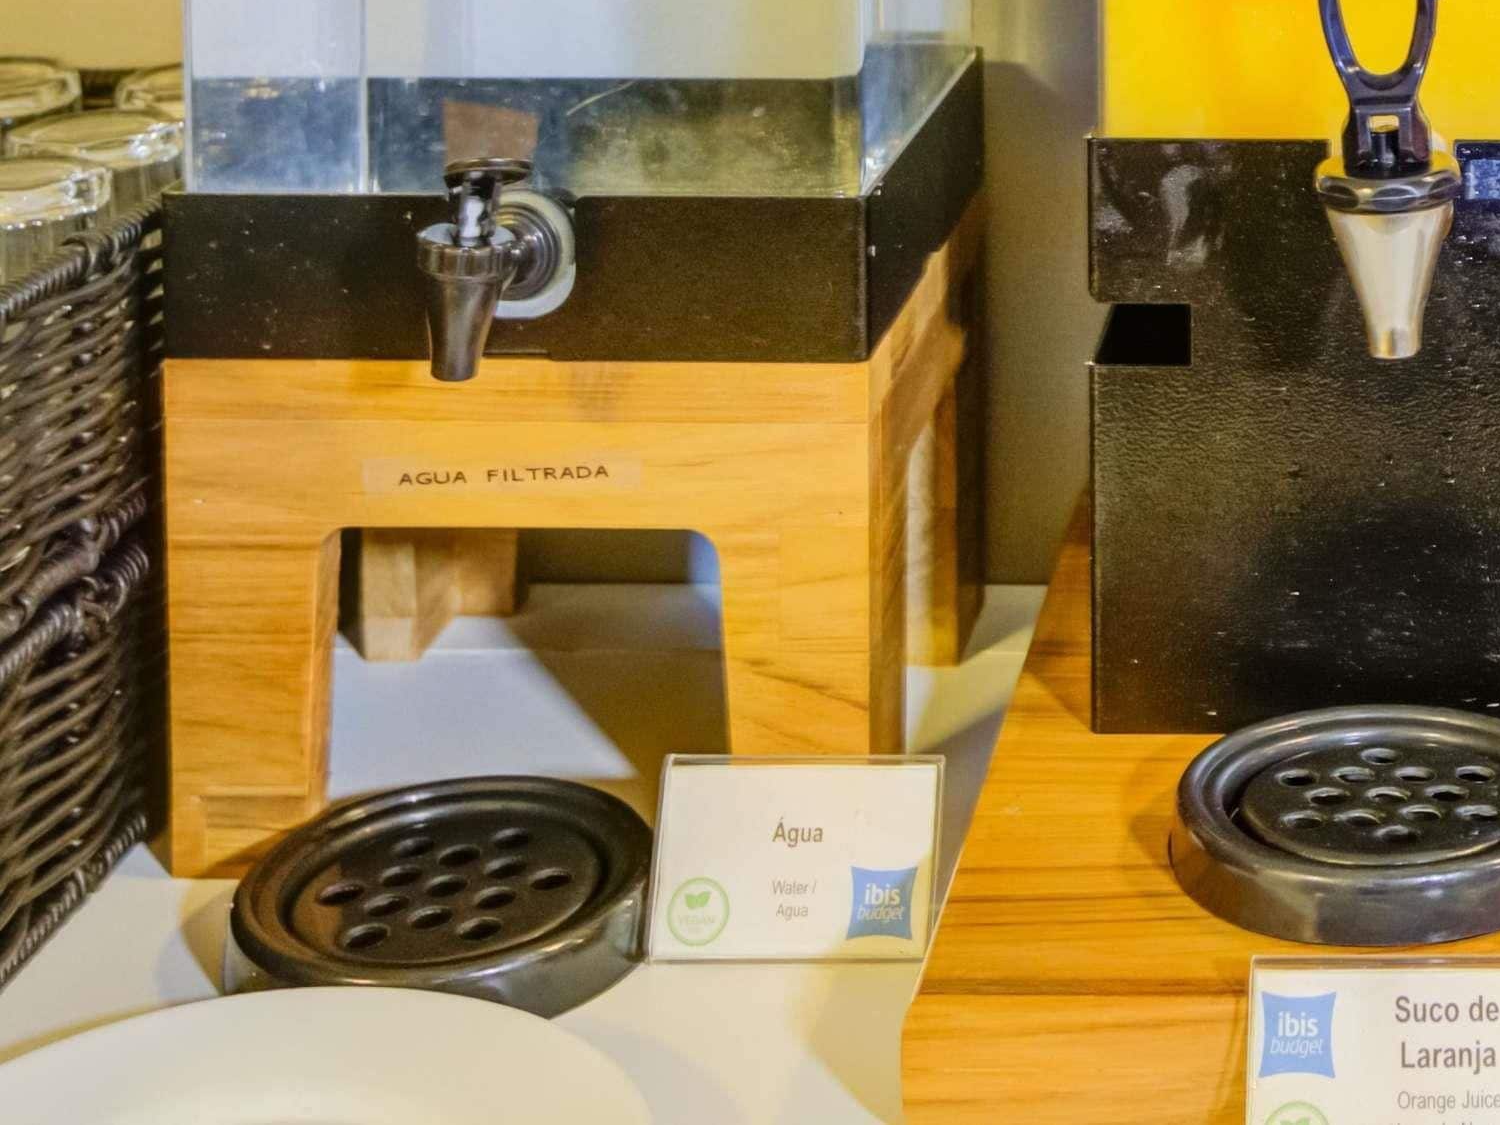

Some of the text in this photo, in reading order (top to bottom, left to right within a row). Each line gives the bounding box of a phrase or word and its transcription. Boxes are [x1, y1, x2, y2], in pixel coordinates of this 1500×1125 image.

[398, 465, 610, 486] AGUA FILTRADA
[771, 816, 825, 848] Água
[771, 879, 808, 896] Water
[864, 882, 901, 906] ibis
[775, 903, 809, 921] Agua
[856, 904, 905, 924] budget
[1394, 994, 1500, 1023] Suco de
[1276, 1010, 1319, 1038] ibis
[1269, 1036, 1324, 1059] budget
[1400, 1040, 1497, 1075] Laranja
[1396, 1090, 1457, 1114] Orange
